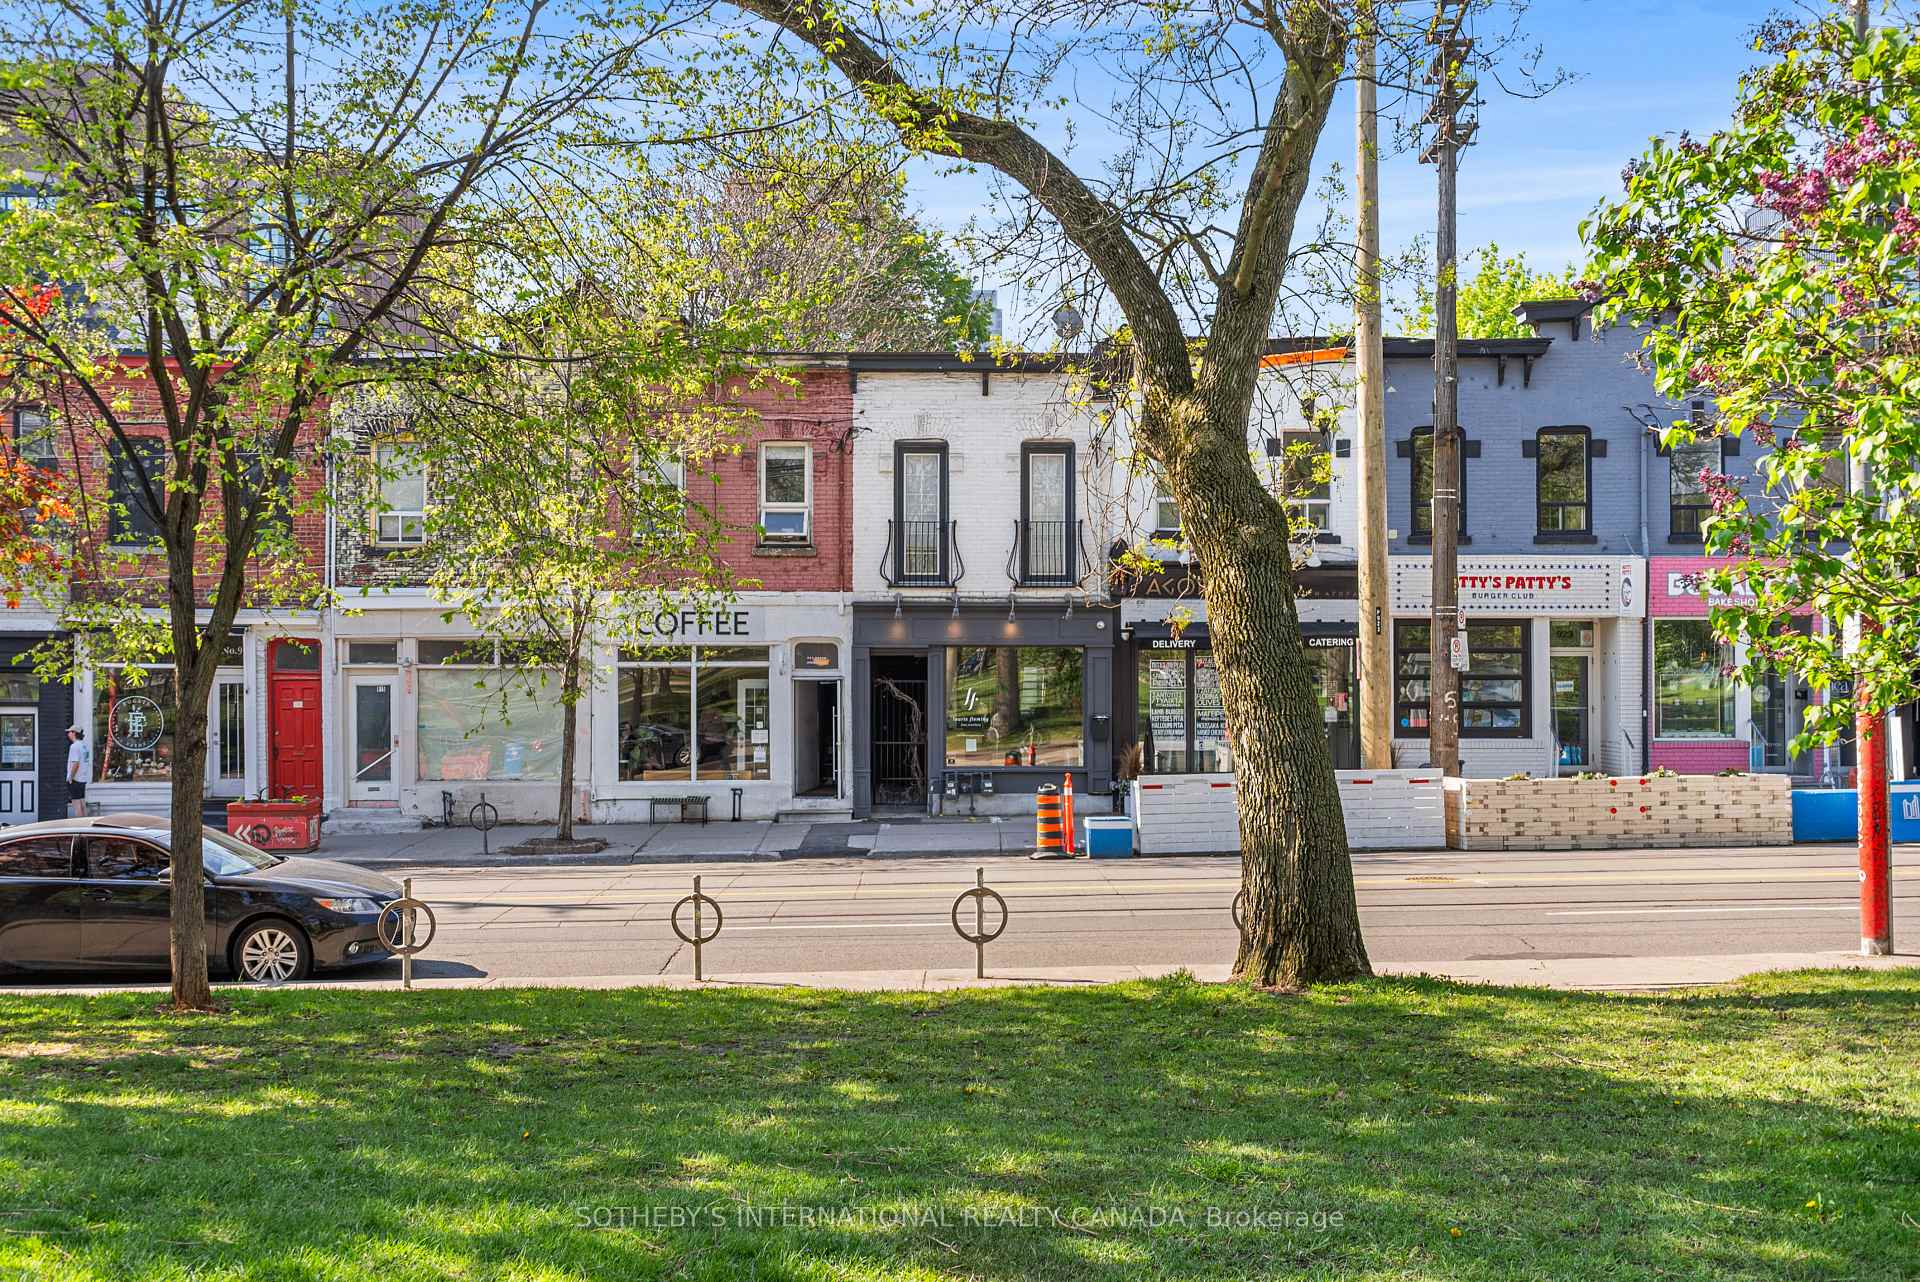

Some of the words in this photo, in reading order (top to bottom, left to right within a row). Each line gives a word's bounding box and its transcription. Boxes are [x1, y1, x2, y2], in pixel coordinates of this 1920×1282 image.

[1459, 576, 1501, 588] TTY'S
[1505, 576, 1571, 589] PATTY'S
[1708, 598, 1732, 606] BAKE
[638, 611, 749, 635] COFFEE
[1152, 640, 1196, 648] DELIVERY
[1309, 638, 1354, 647] CATERING
